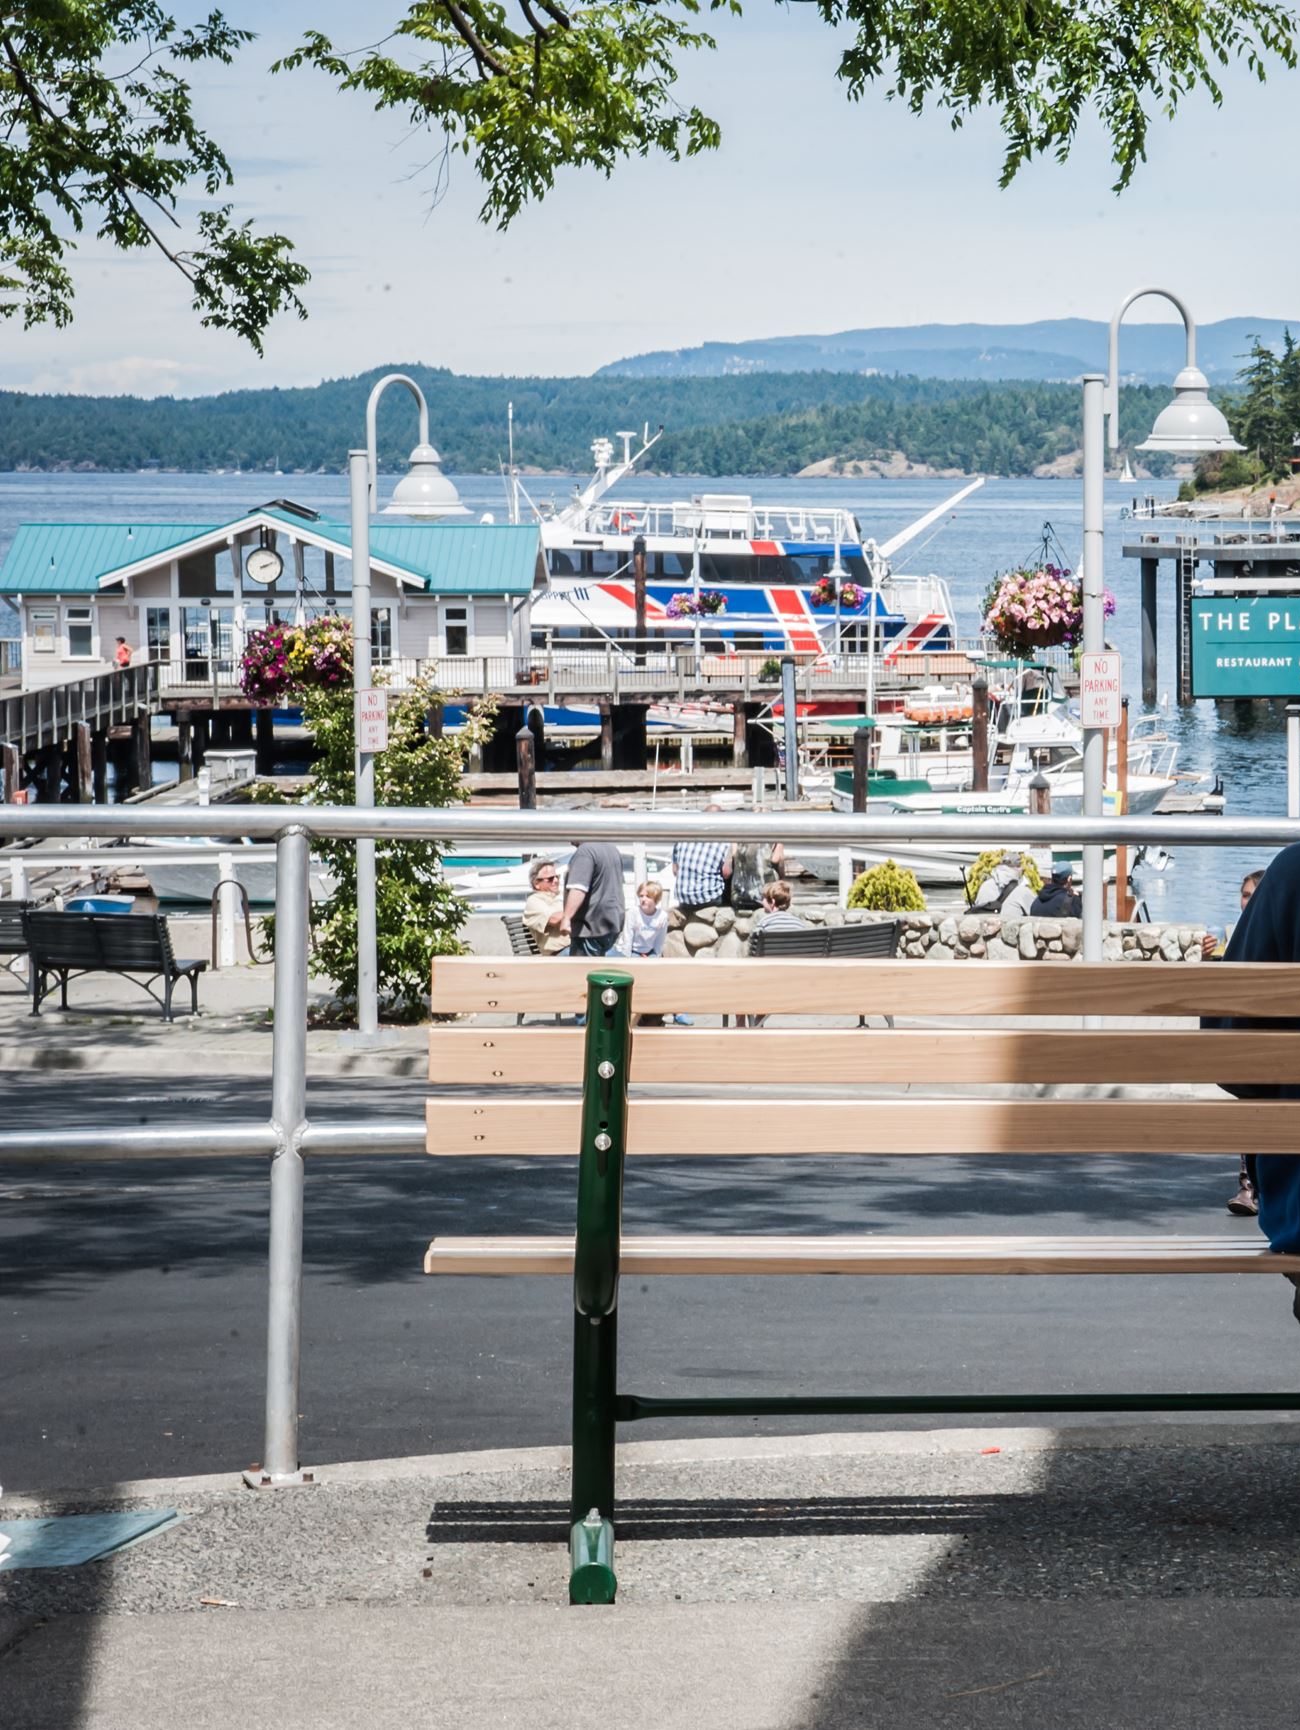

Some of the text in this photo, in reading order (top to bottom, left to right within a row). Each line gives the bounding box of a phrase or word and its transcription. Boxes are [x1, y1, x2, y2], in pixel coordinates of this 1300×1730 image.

[573, 587, 590, 600] III
[1199, 612, 1250, 631] THE
[1094, 661, 1108, 674] NO
[1216, 657, 1292, 667] RESTAURANT
[1084, 679, 1118, 692] PARKING
[368, 695, 377, 706] NO
[1094, 697, 1108, 705] ANY
[362, 711, 385, 721] PARKING
[1093, 710, 1109, 720] TIME
